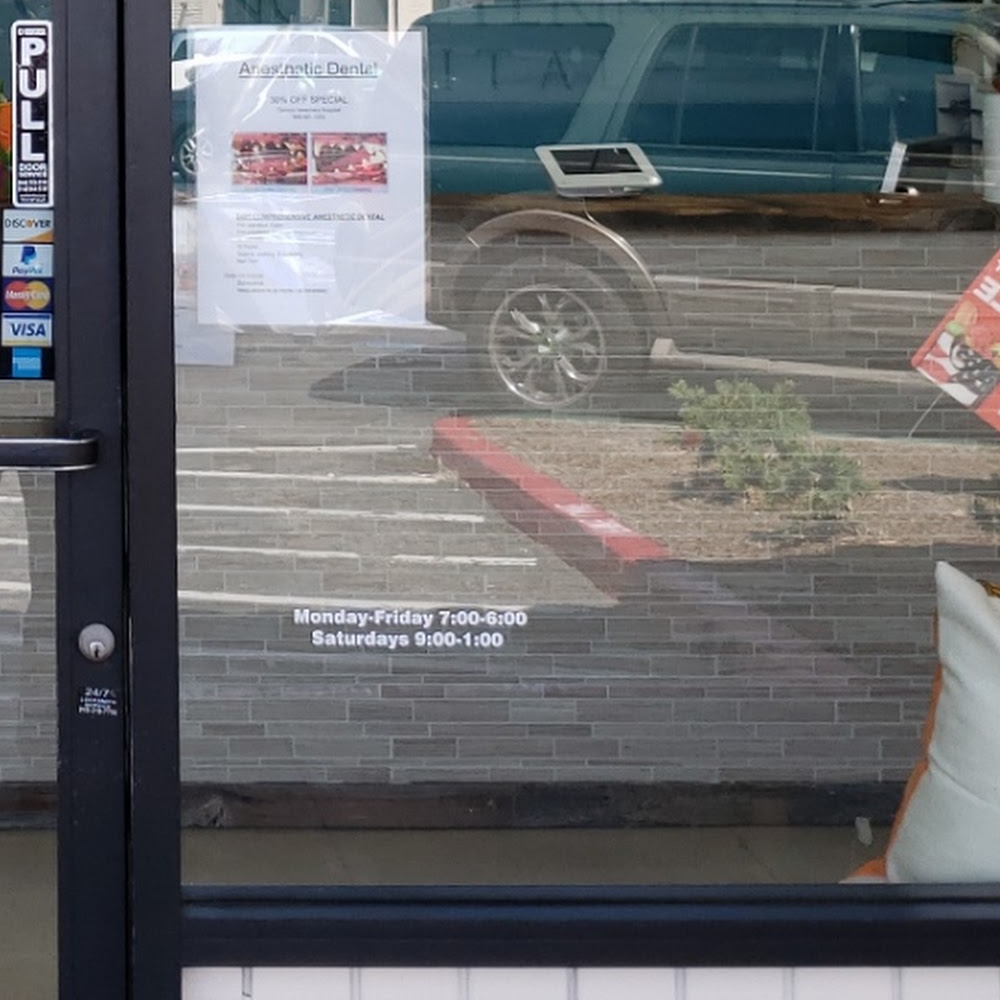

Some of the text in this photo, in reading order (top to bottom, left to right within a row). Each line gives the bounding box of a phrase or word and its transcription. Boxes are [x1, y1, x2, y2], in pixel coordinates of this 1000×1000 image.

[18, 37, 47, 162] PULL
[4, 218, 51, 229] DISCOVER
[10, 322, 47, 337] VISA
[293, 608, 528, 629] Monday-Friday 7:00-6:00
[311, 629, 505, 650] Saturdays 9:00-1:00
